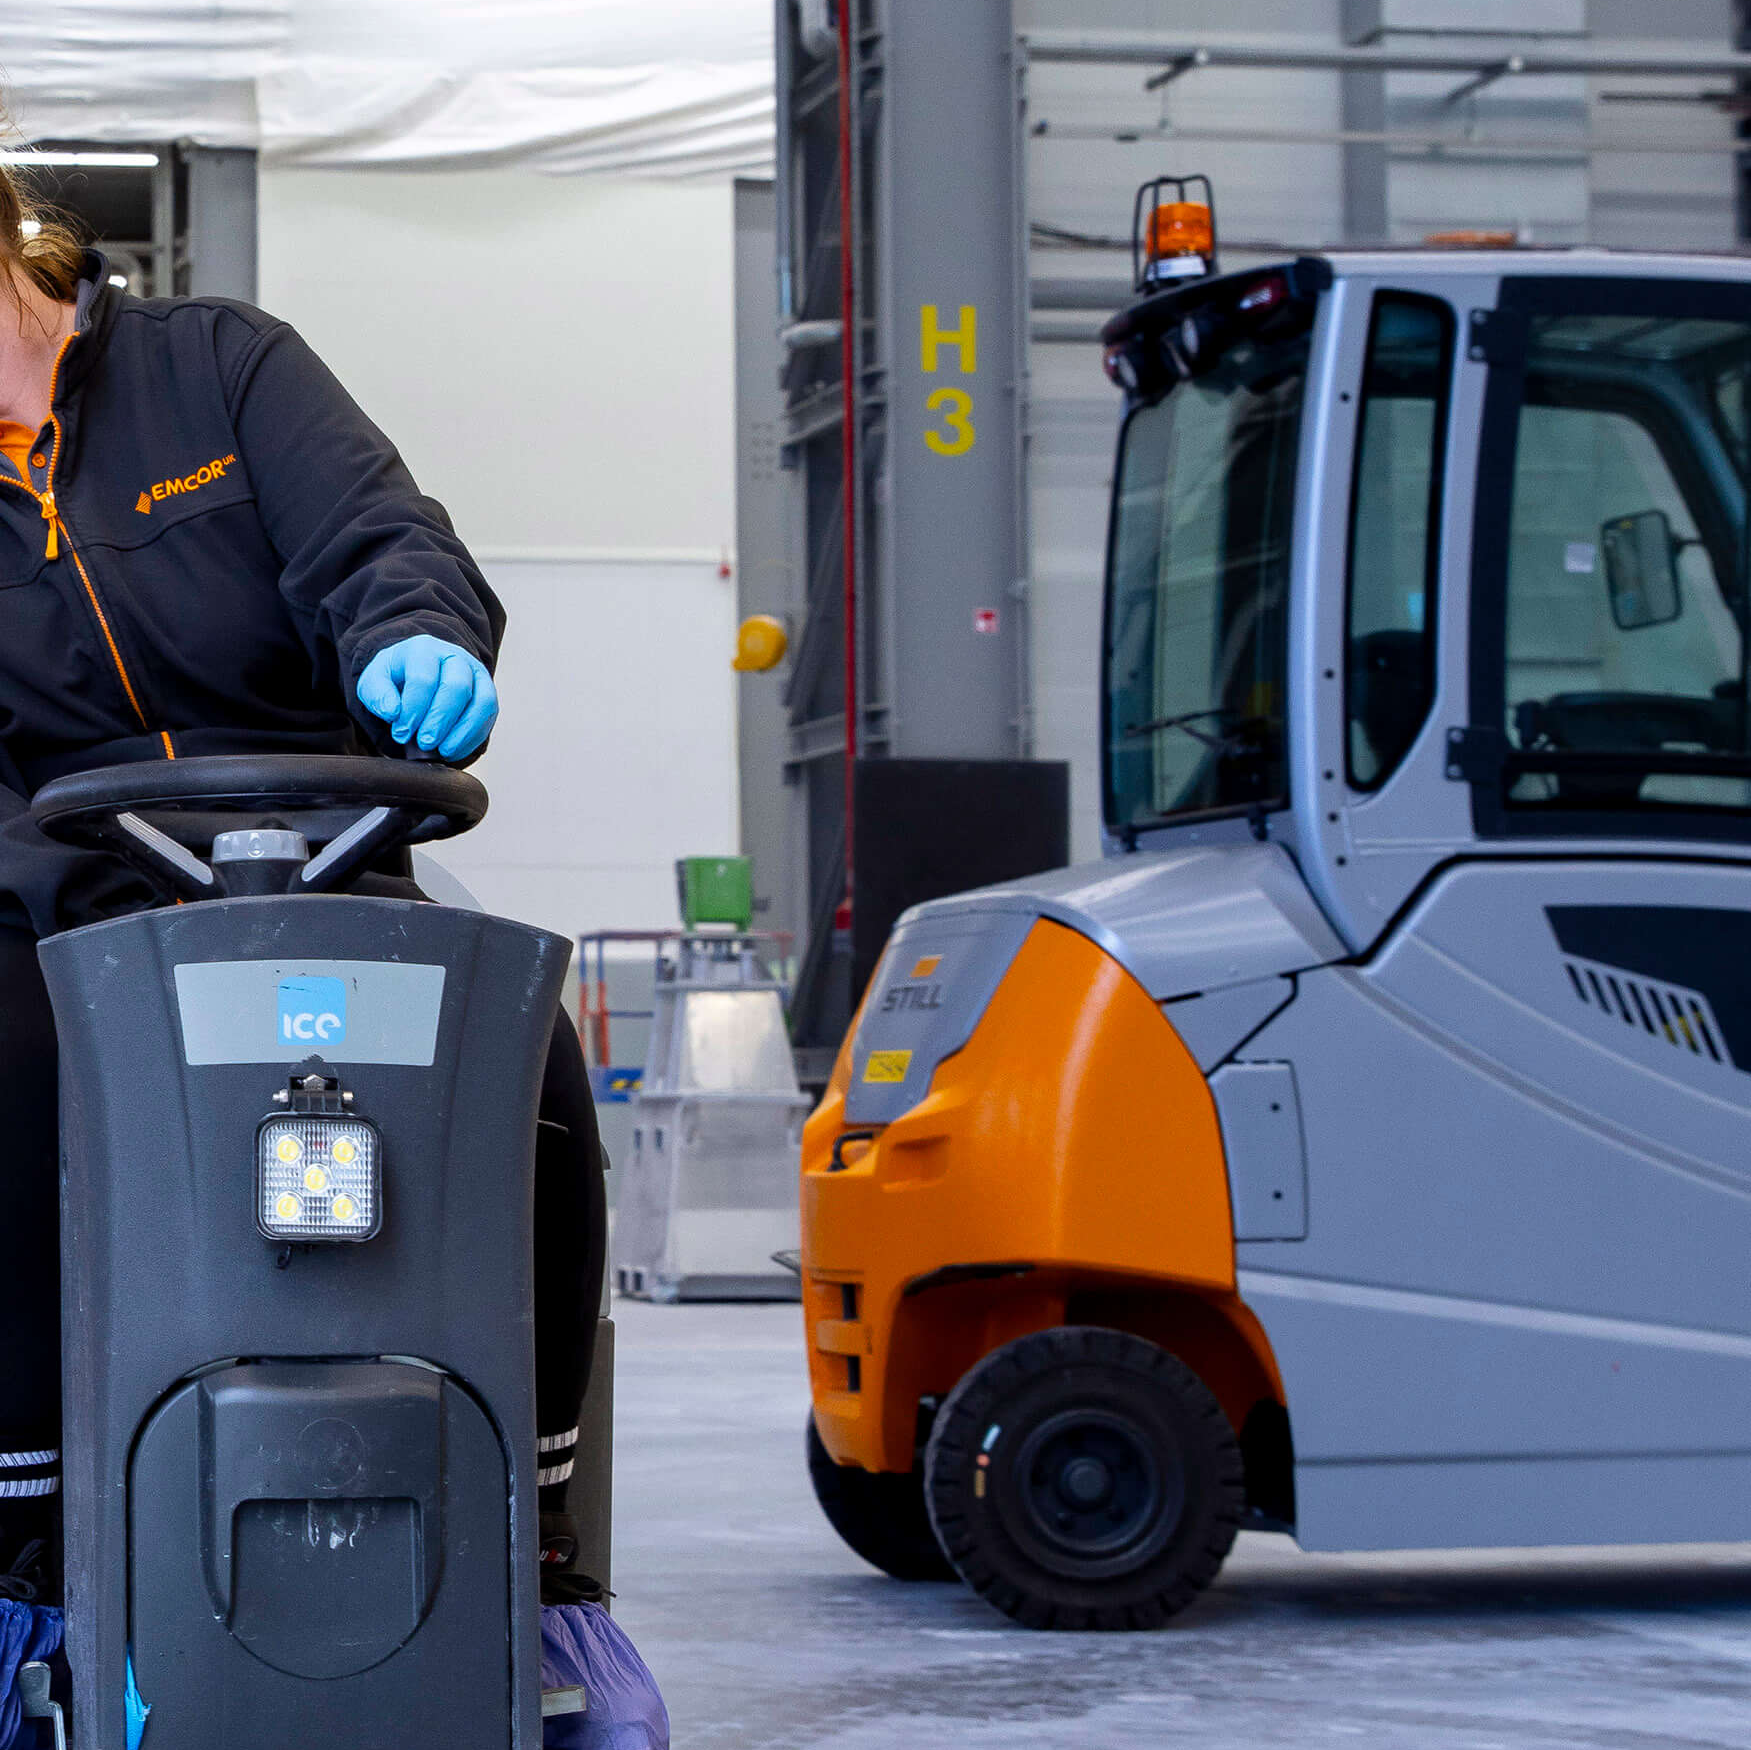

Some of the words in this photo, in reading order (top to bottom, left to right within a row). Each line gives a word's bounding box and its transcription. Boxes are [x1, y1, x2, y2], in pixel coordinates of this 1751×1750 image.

[921, 305, 976, 373] H
[924, 387, 975, 456] 3
[151, 459, 226, 501] EMCOR
[881, 984, 942, 1012] STILL
